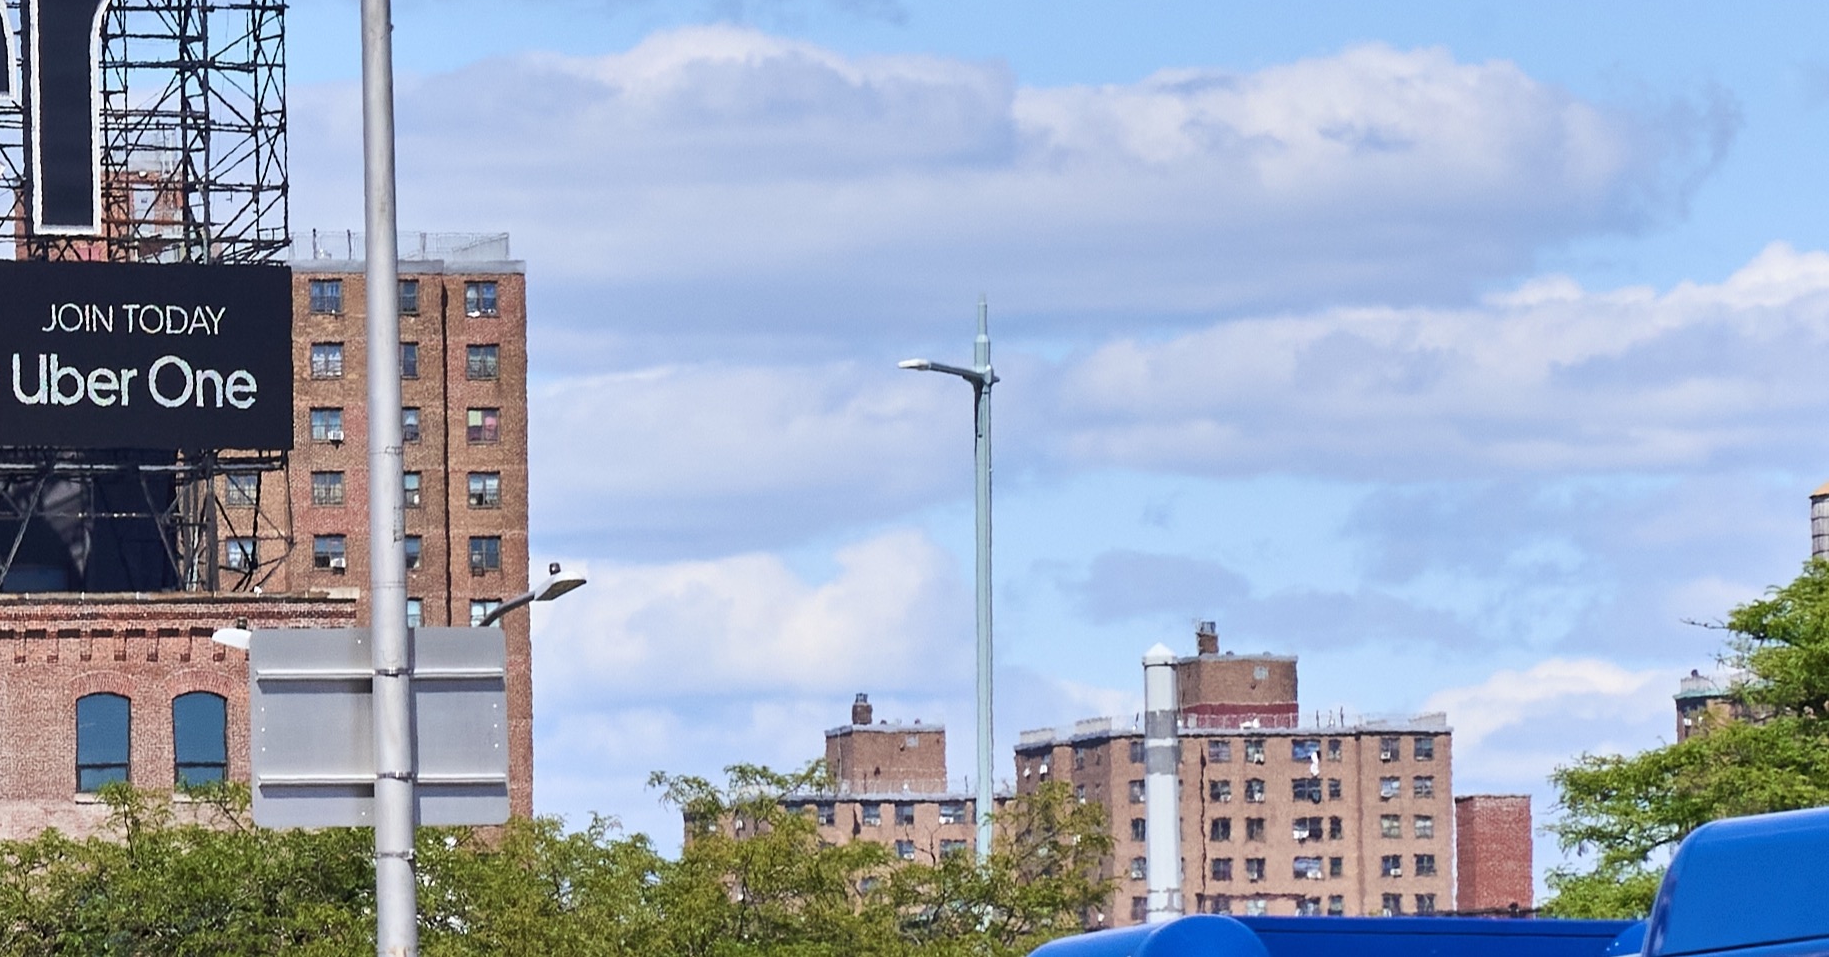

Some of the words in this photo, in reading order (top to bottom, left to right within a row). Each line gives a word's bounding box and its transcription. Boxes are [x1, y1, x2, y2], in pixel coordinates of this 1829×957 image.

[41, 302, 114, 333] JOIN
[122, 303, 226, 336] TODAY
[11, 352, 138, 407] Uber
[147, 354, 258, 410] One
